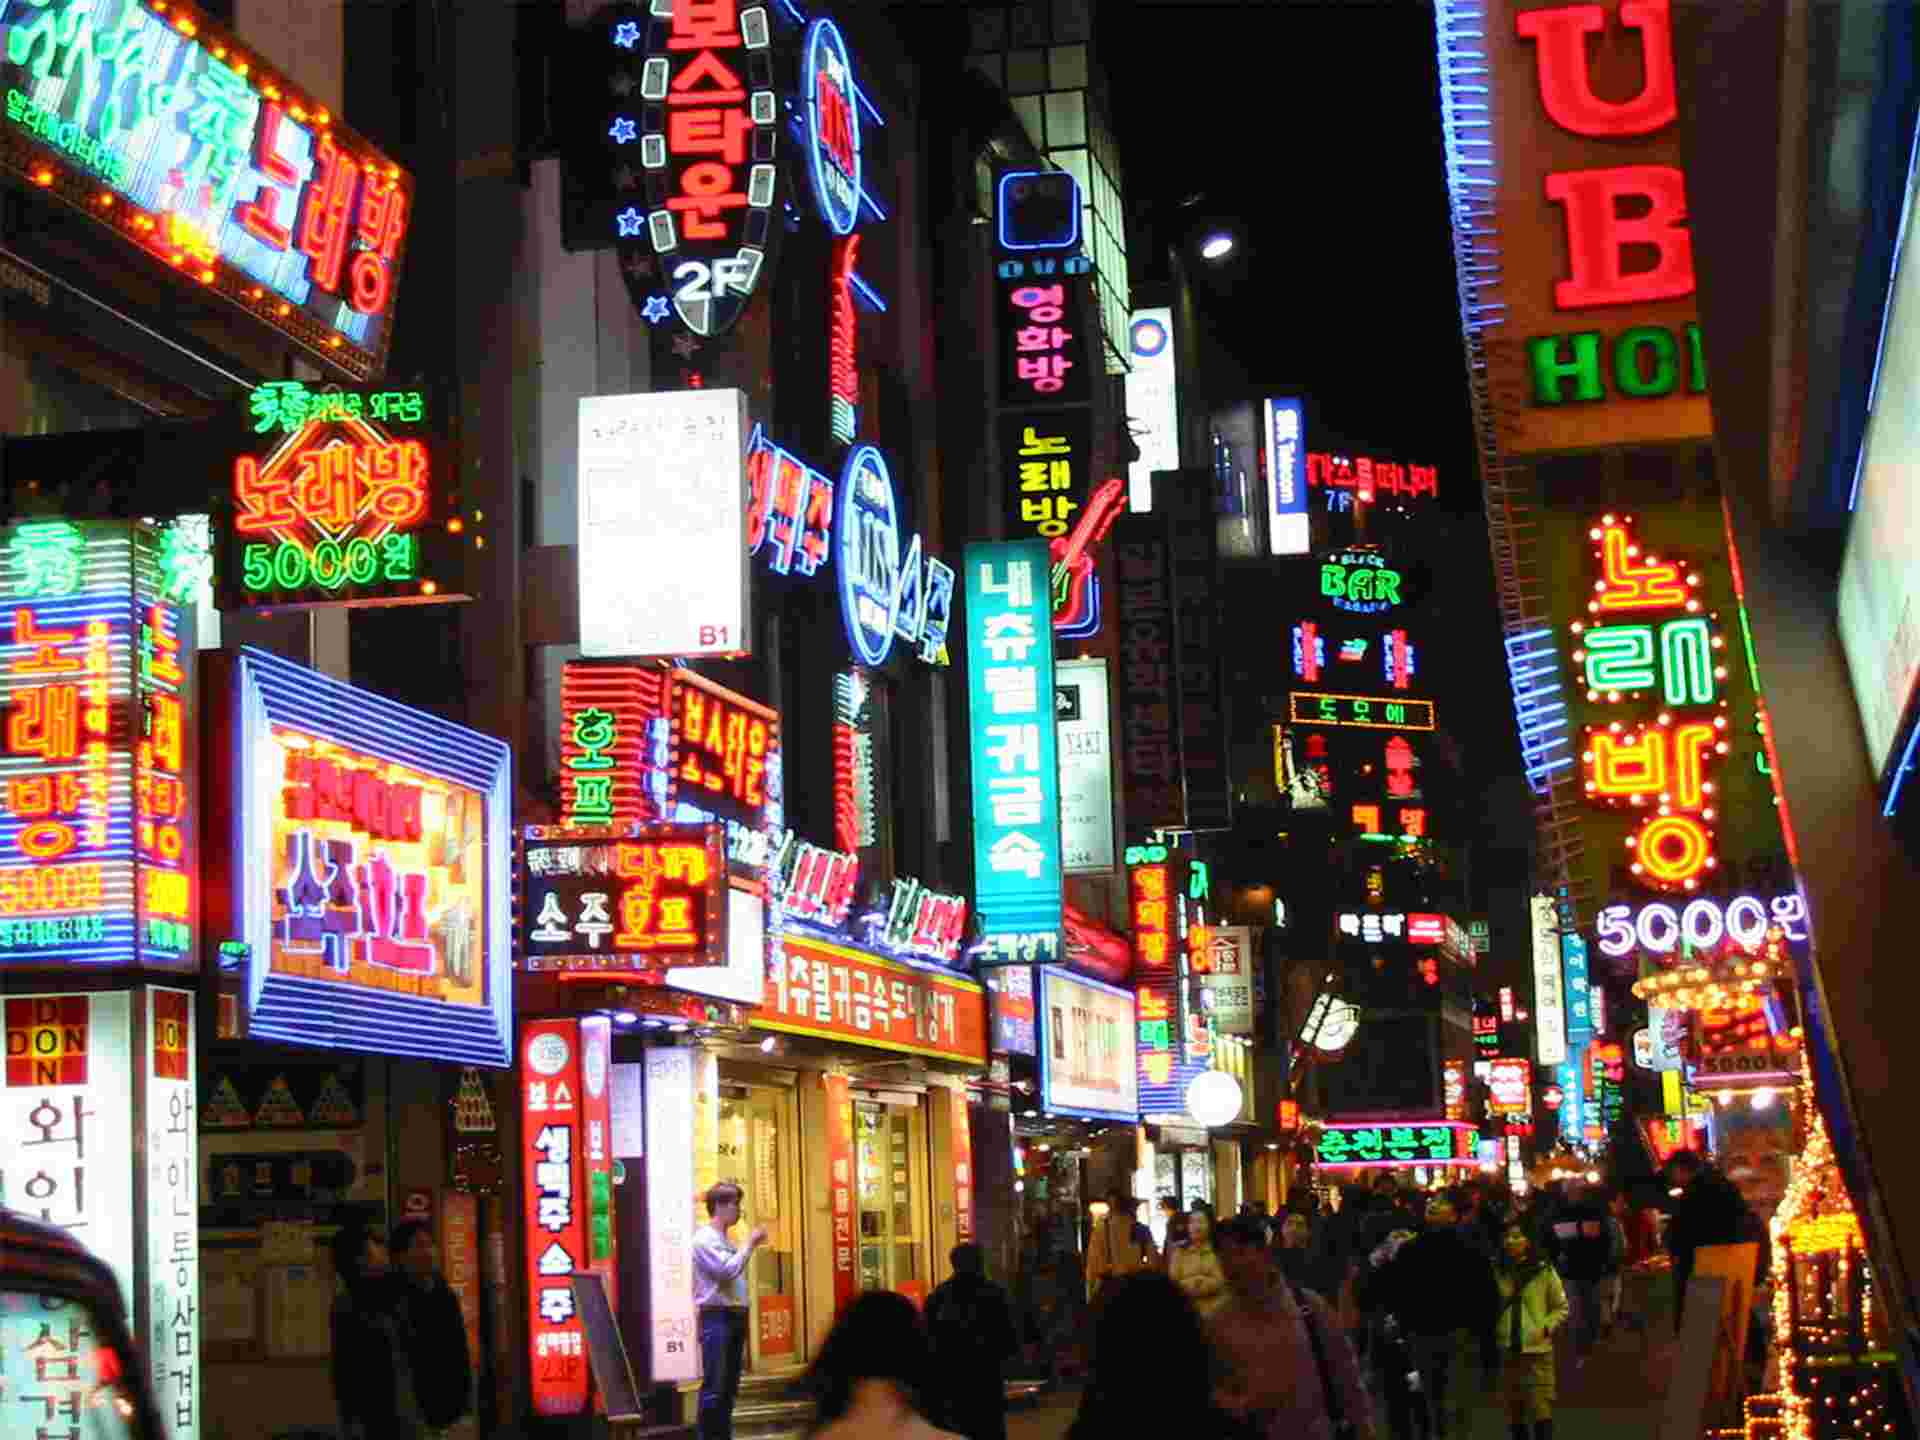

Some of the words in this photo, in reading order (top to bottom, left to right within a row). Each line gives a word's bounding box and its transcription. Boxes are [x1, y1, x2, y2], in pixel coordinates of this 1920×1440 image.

[234, 98, 409, 316] 노래방
[672, 258, 749, 300] 2F
[1011, 284, 1073, 392] 영화방
[235, 441, 429, 533] 노래방
[1018, 427, 1078, 537] 노래방
[243, 533, 415, 591] 5000원
[1320, 564, 1402, 605] BAR
[699, 625, 730, 647] B1
[8, 608, 82, 858] 노래방
[979, 560, 1046, 880] 내츄럴귀금속
[1583, 527, 1715, 880] 노래방
[569, 707, 616, 824] 호프
[529, 891, 614, 949] 소주
[615, 885, 698, 947] 호프
[1597, 893, 1807, 956] 5000원
[527, 1081, 574, 1111] 보스
[666, 1340, 686, 1354] B1
